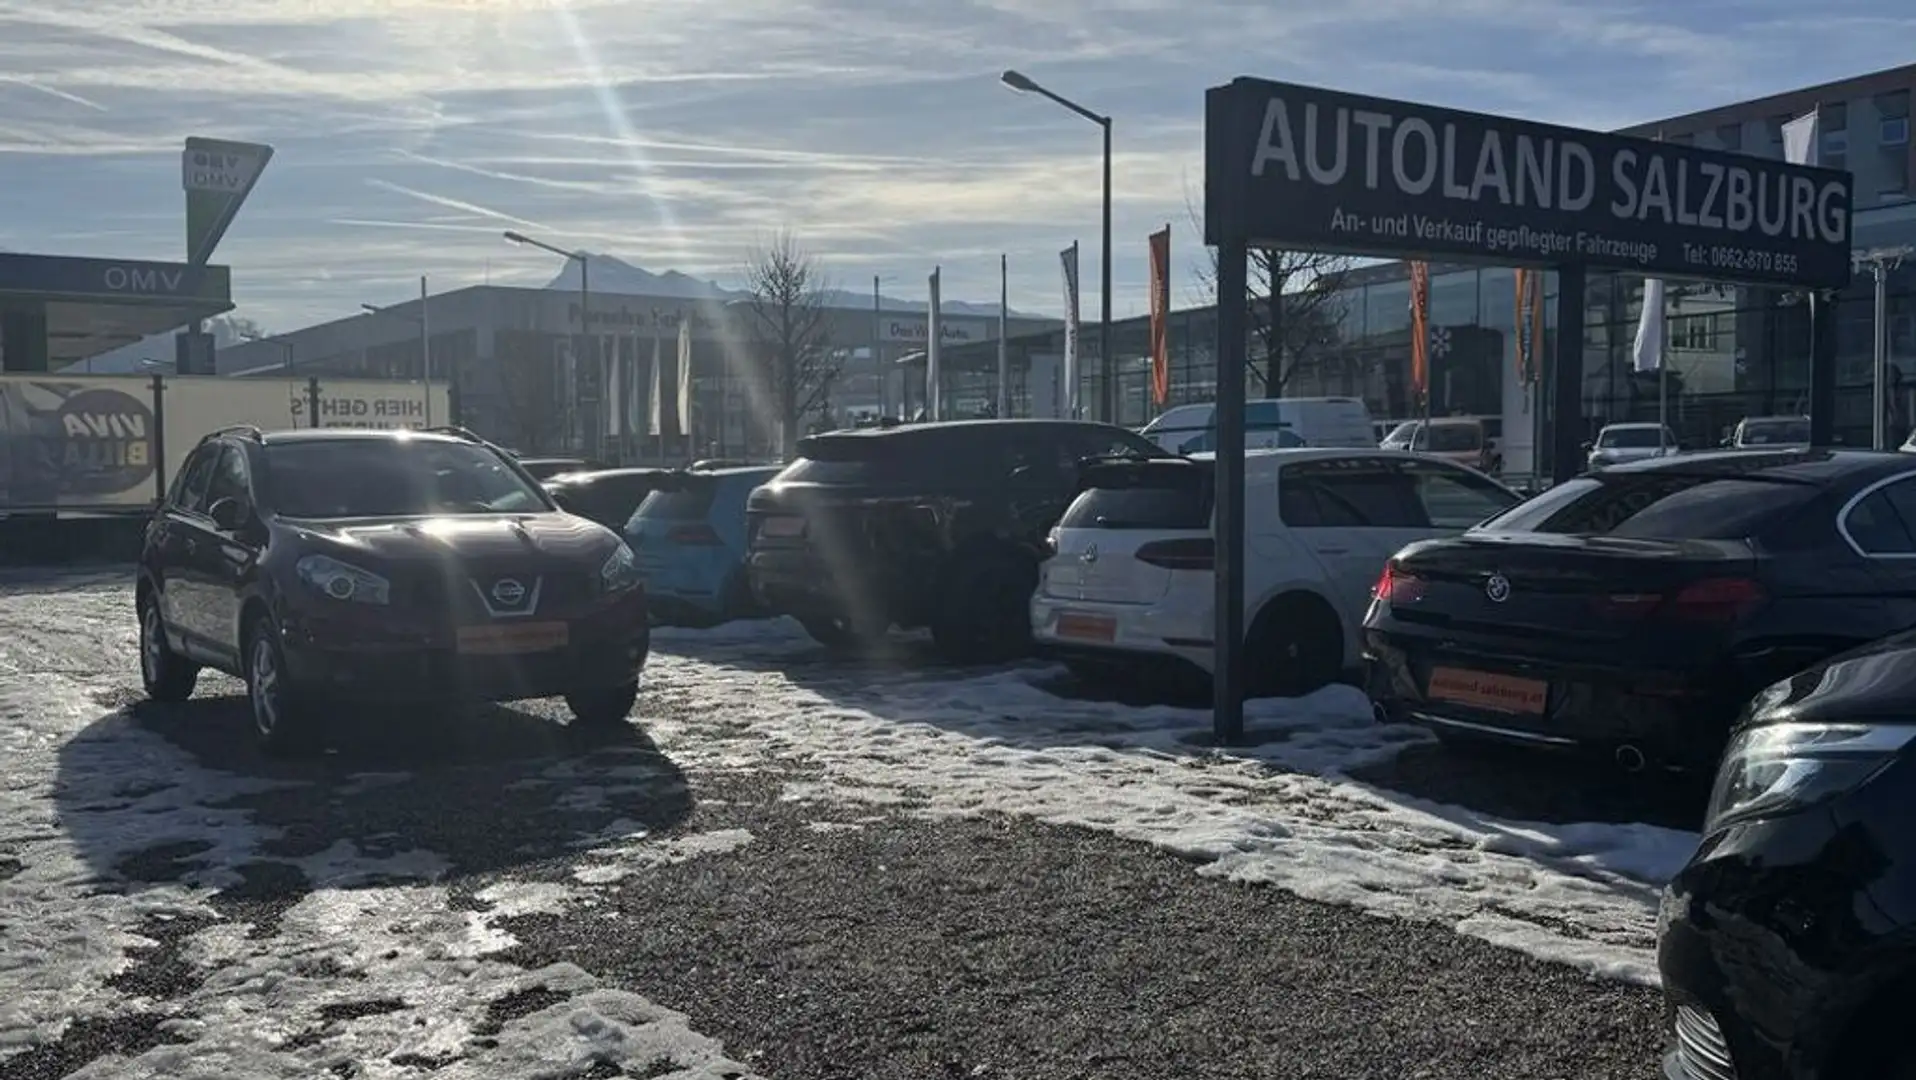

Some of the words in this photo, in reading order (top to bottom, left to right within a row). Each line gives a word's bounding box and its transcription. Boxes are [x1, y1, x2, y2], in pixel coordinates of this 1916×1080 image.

[1251, 97, 1595, 211] AUTOLAND
[1611, 149, 1848, 243] SALZBURG
[1331, 206, 1367, 232] An-
[1372, 213, 1408, 237] und
[1413, 214, 1483, 245] Verkauf
[1486, 224, 1572, 255] gepflegter
[1576, 231, 1658, 264] Fahrzeuge
[104, 266, 182, 292] OMV
[1711, 246, 1772, 271] 0662-870
[1775, 253, 1798, 274] 855
